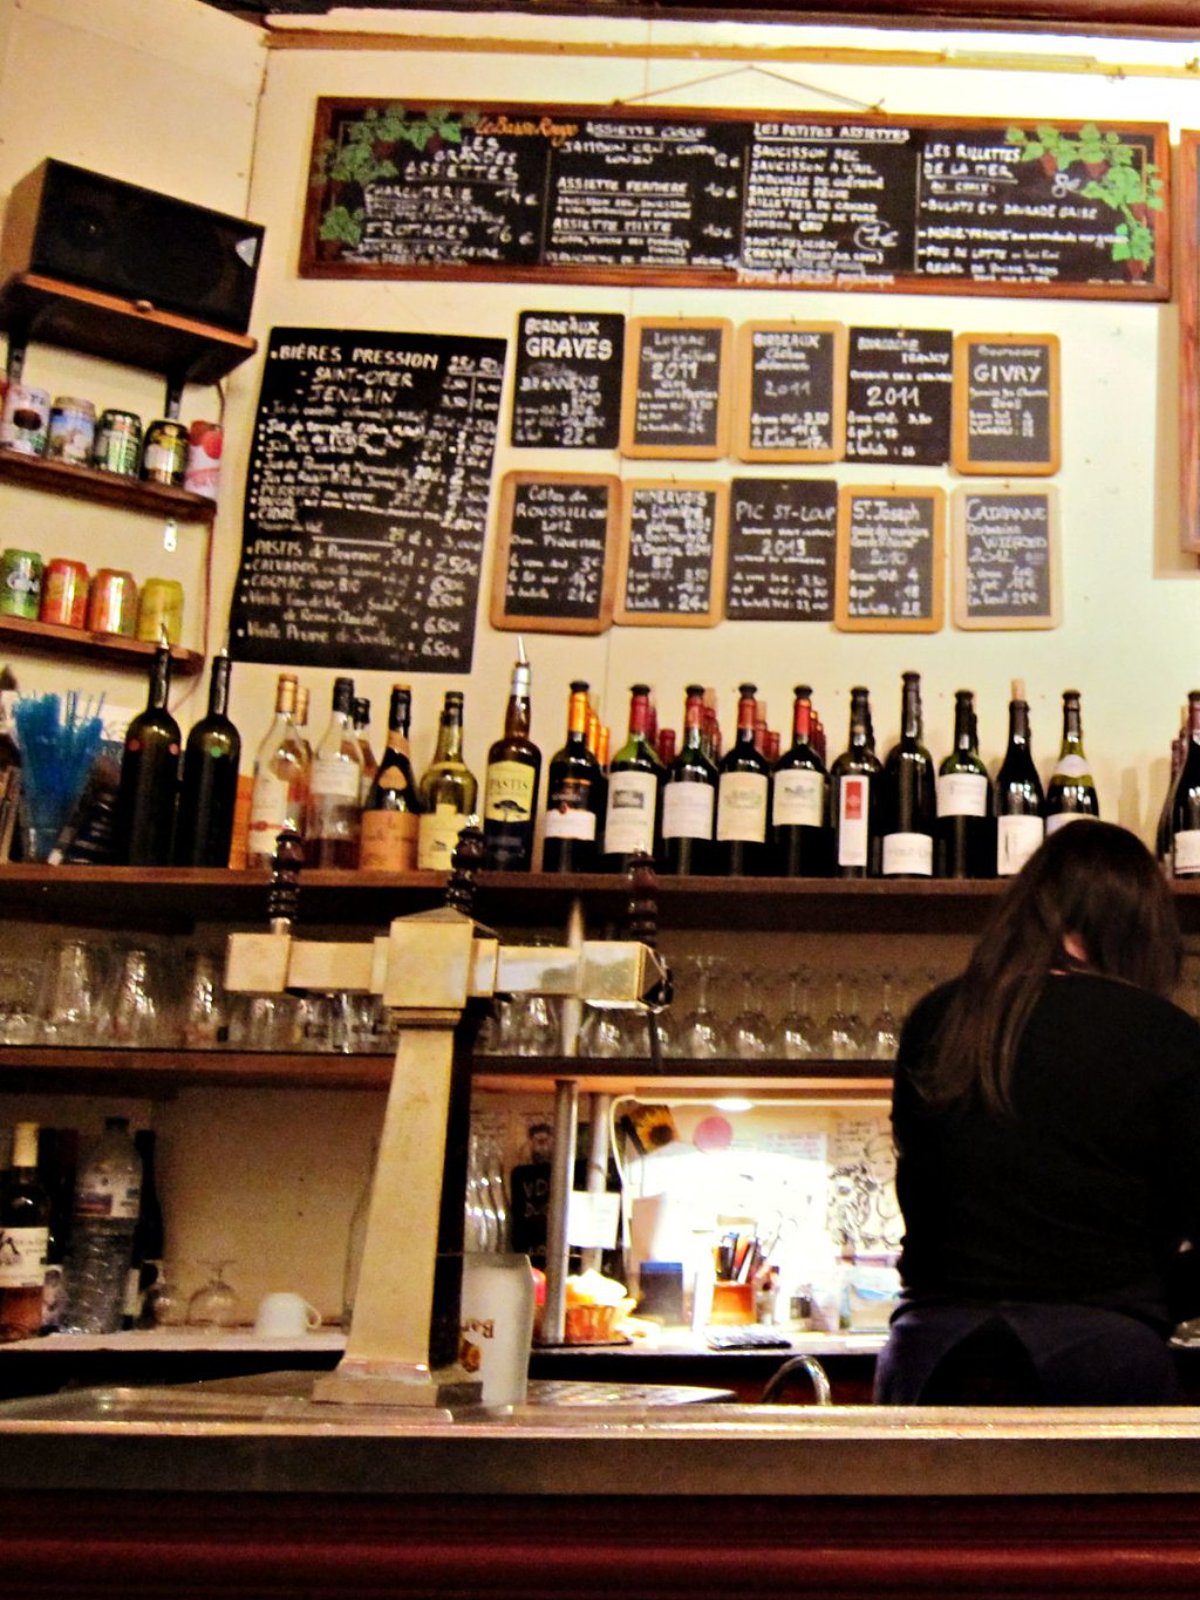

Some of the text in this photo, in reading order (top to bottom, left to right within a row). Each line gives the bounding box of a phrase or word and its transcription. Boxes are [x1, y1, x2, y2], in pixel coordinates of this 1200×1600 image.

[352, 346, 439, 371] PRESSION
[525, 337, 613, 361] GRAVES
[972, 363, 1043, 384] GIVRY
[867, 386, 921, 408] 2011
[735, 501, 764, 521] PIC
